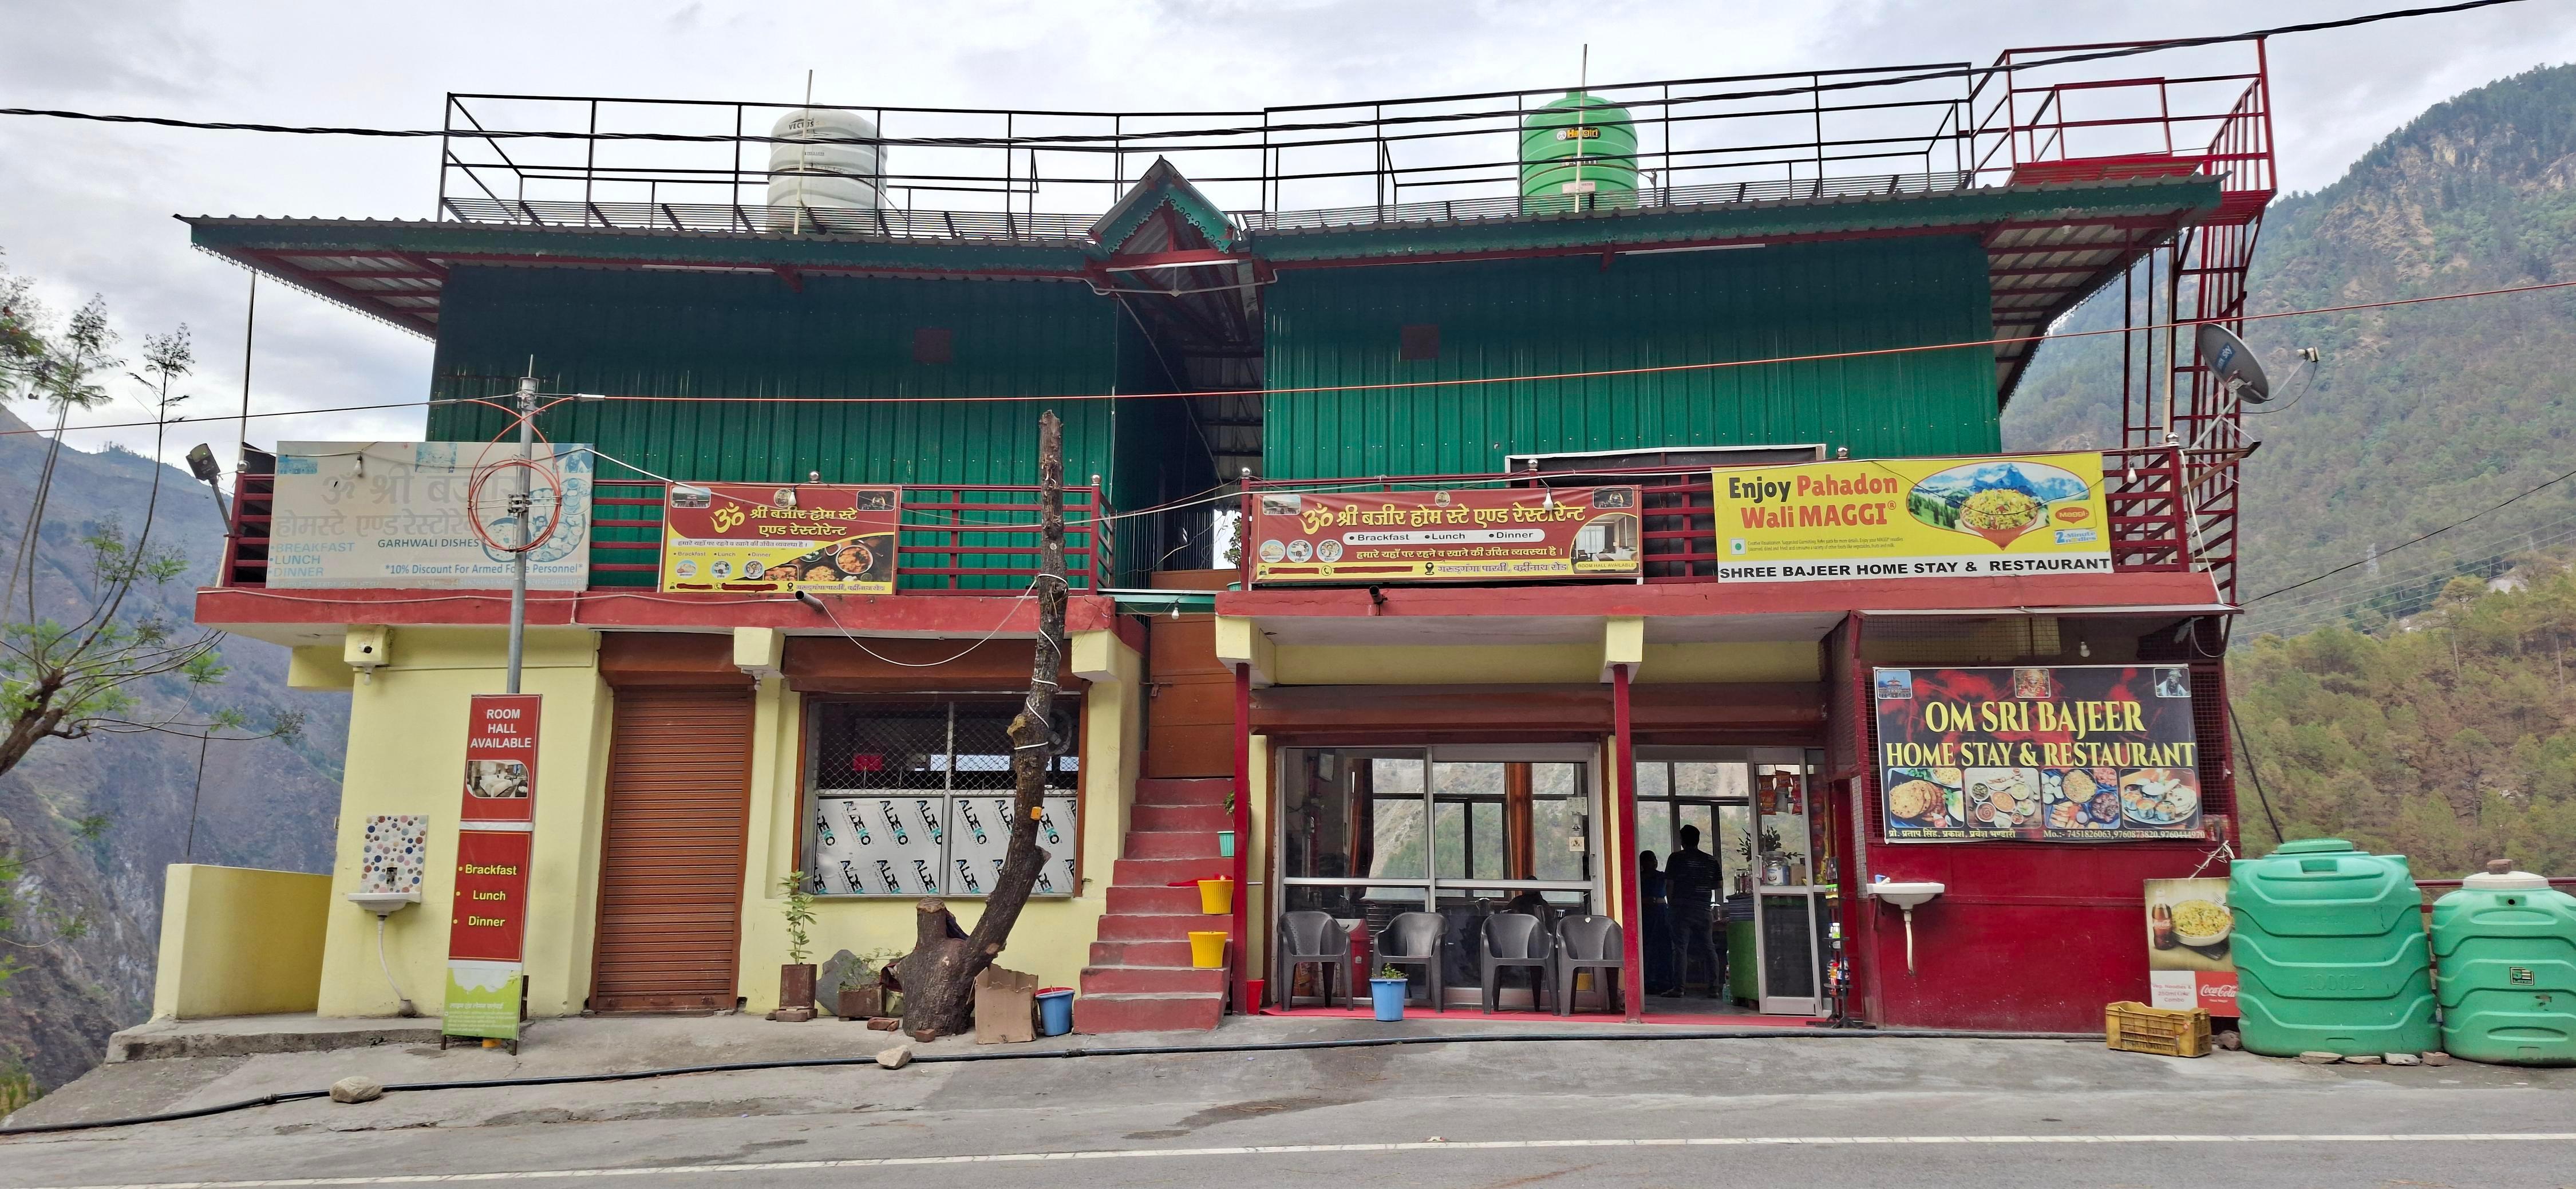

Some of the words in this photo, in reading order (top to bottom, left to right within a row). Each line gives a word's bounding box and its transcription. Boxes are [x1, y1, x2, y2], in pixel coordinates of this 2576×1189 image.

[370, 464, 414, 504] श्री
[1729, 476, 1791, 503] Enjoy
[1796, 473, 1898, 497] Pahadon
[750, 505, 768, 519] श्री
[771, 505, 807, 520] बजीर
[810, 507, 836, 521] होम
[839, 507, 858, 520] स्टे
[1337, 504, 1358, 527] श्री
[1362, 504, 1406, 526] बजीर
[1411, 504, 1443, 527] होम
[1446, 503, 1469, 524] स्टे
[1473, 508, 1509, 528] एण्ड
[1512, 501, 1586, 523] रेस्टोरेन्ट
[1740, 504, 1794, 530] Wali
[758, 525, 788, 538] एण्ड
[790, 523, 848, 536] रेस्टोरेन्ट
[276, 542, 355, 553] BREAKFAST
[378, 539, 437, 548] GARHWALI
[441, 539, 479, 547] DISHES
[1356, 549, 1380, 559] हमारे
[1381, 548, 1400, 558] यहाँ
[1416, 548, 1436, 558] रहने
[1447, 548, 1468, 557] खाने
[1470, 547, 1484, 556] की
[1485, 547, 1510, 556] उचित
[1511, 548, 1547, 556] व्यवस्था
[1548, 546, 1557, 556] है
[275, 555, 321, 564] LUNCH
[274, 567, 324, 577] DINNER
[412, 564, 452, 574] Discount
[455, 564, 469, 574] For
[472, 564, 503, 573] Armed
[506, 564, 530, 573] Foe
[1720, 566, 1777, 579] SHREE
[1783, 563, 1851, 577] BAJEER
[1856, 562, 1908, 576] HOME
[1914, 560, 1957, 574] STAY
[1965, 560, 1977, 573] &
[1990, 556, 2111, 572] RESTAURANT
[487, 709, 520, 720] ROOM
[1925, 702, 1974, 733] OM
[1981, 702, 2029, 733] SRI
[2038, 701, 2147, 740] BAJEER
[488, 723, 517, 734] HALL
[470, 737, 532, 749] AVAILABLE
[1886, 742, 1955, 768] HOME
[1961, 742, 2014, 768] STAY
[2020, 742, 2037, 767] &
[2045, 741, 2196, 767] RESTAURANT
[880, 801, 908, 845] ALDEKO
[958, 800, 987, 844] ALDEKO
[1969, 828, 1988, 838] प्रवेश
[465, 864, 517, 876] Brackfast
[473, 890, 506, 902] Lunch
[468, 916, 505, 927] Dinner
